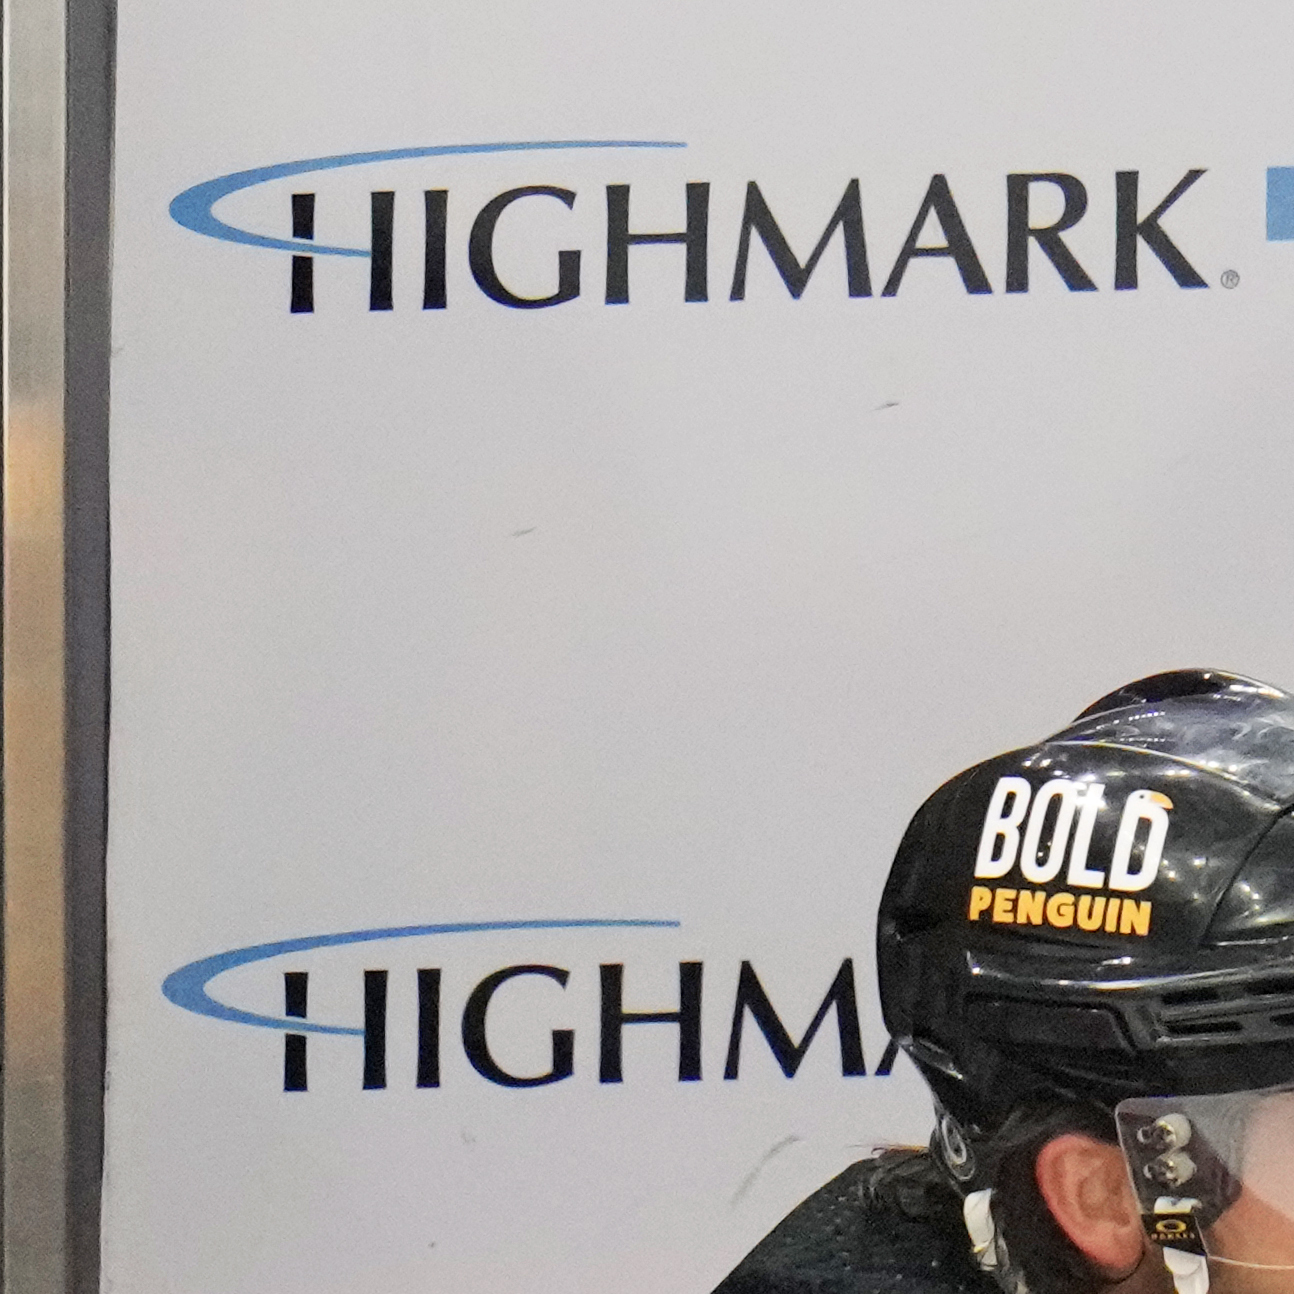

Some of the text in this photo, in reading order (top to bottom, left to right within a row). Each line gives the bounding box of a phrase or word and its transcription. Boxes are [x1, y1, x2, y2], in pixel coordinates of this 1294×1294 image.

[289, 168, 1209, 314] HIGHMARK
[974, 776, 1174, 892] BOLD
[968, 885, 1152, 936] PENGUIN
[282, 958, 896, 1092] HIGHM
